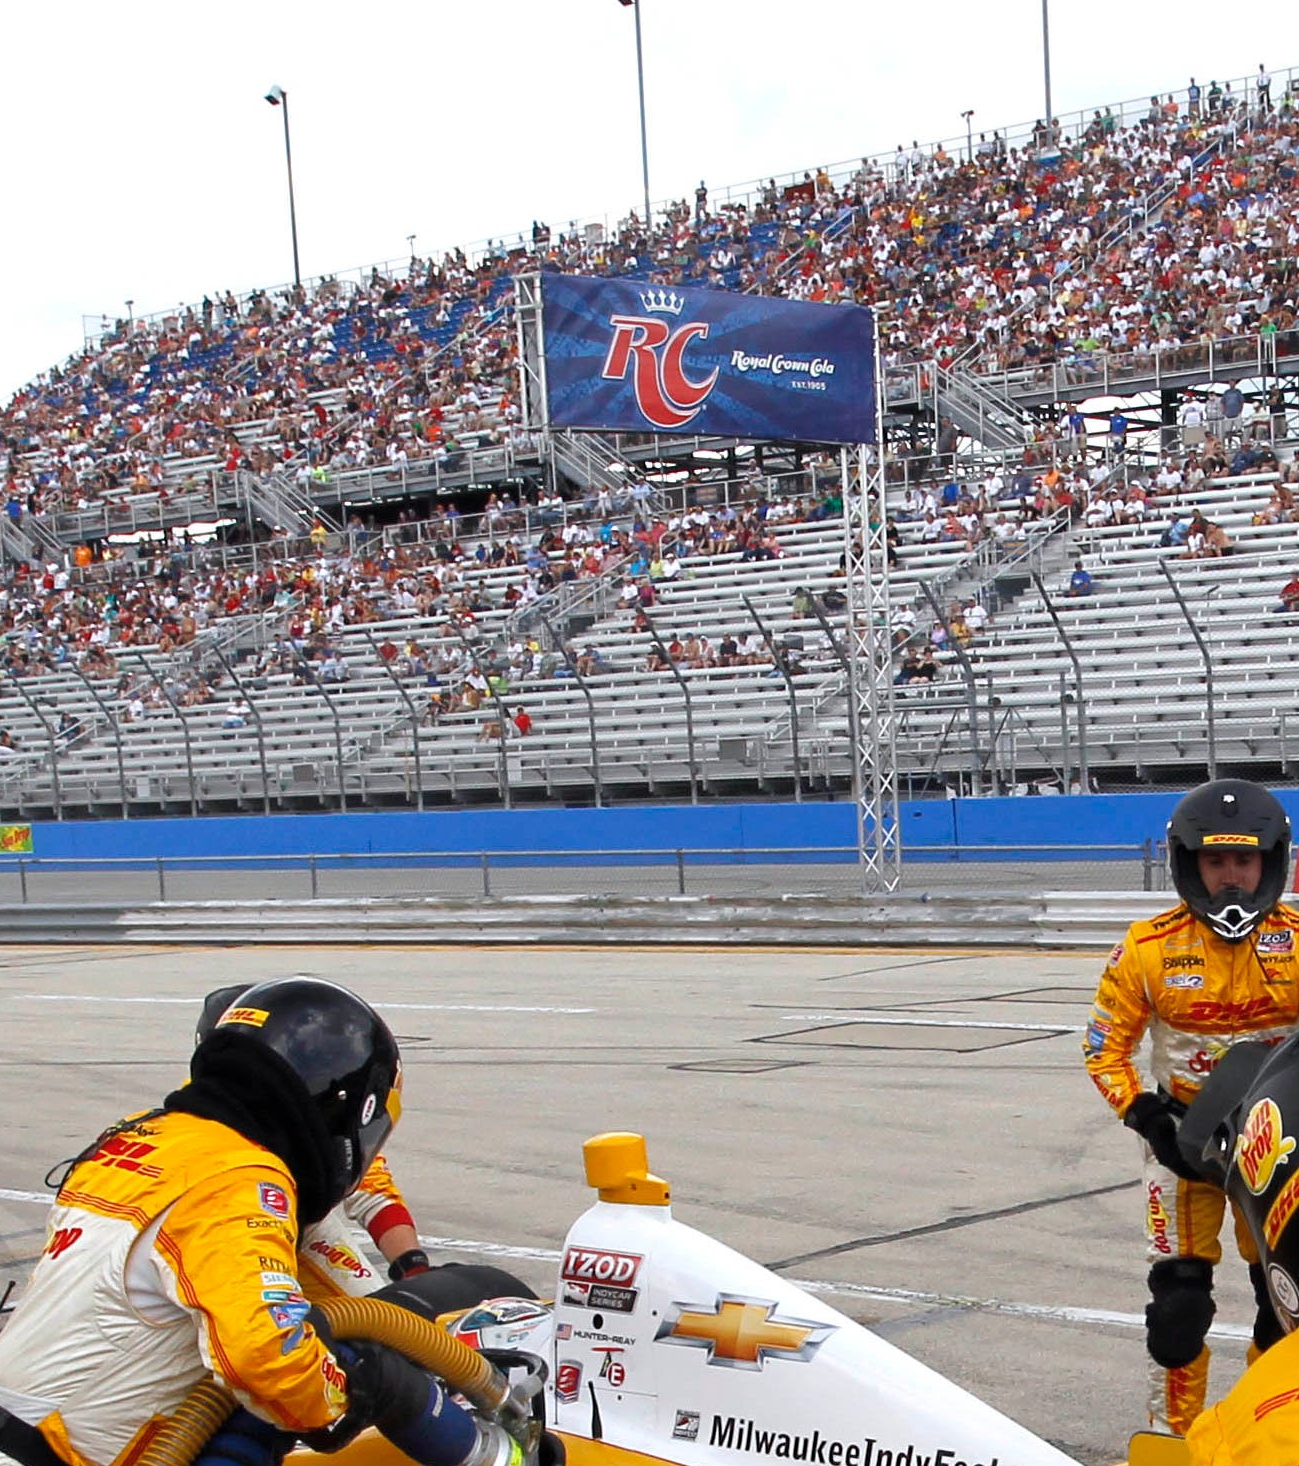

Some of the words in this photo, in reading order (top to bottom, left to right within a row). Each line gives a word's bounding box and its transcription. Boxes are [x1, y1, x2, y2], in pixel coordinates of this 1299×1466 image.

[602, 314, 719, 428] RC
[731, 350, 771, 370] Royal
[771, 355, 810, 375] Crown
[809, 357, 835, 378] Cola
[1211, 835, 1251, 844] DHL
[1188, 995, 1277, 1021] DHL
[1187, 1050, 1220, 1074] Su
[1241, 1120, 1274, 1188] Drop
[309, 1239, 343, 1264] Drop
[343, 1254, 373, 1280] Sun
[564, 1251, 635, 1282] IZOD
[591, 1297, 624, 1309] SERIES
[592, 1288, 631, 1301] INDYCAR
[573, 1330, 636, 1346] HUNTER-REAY
